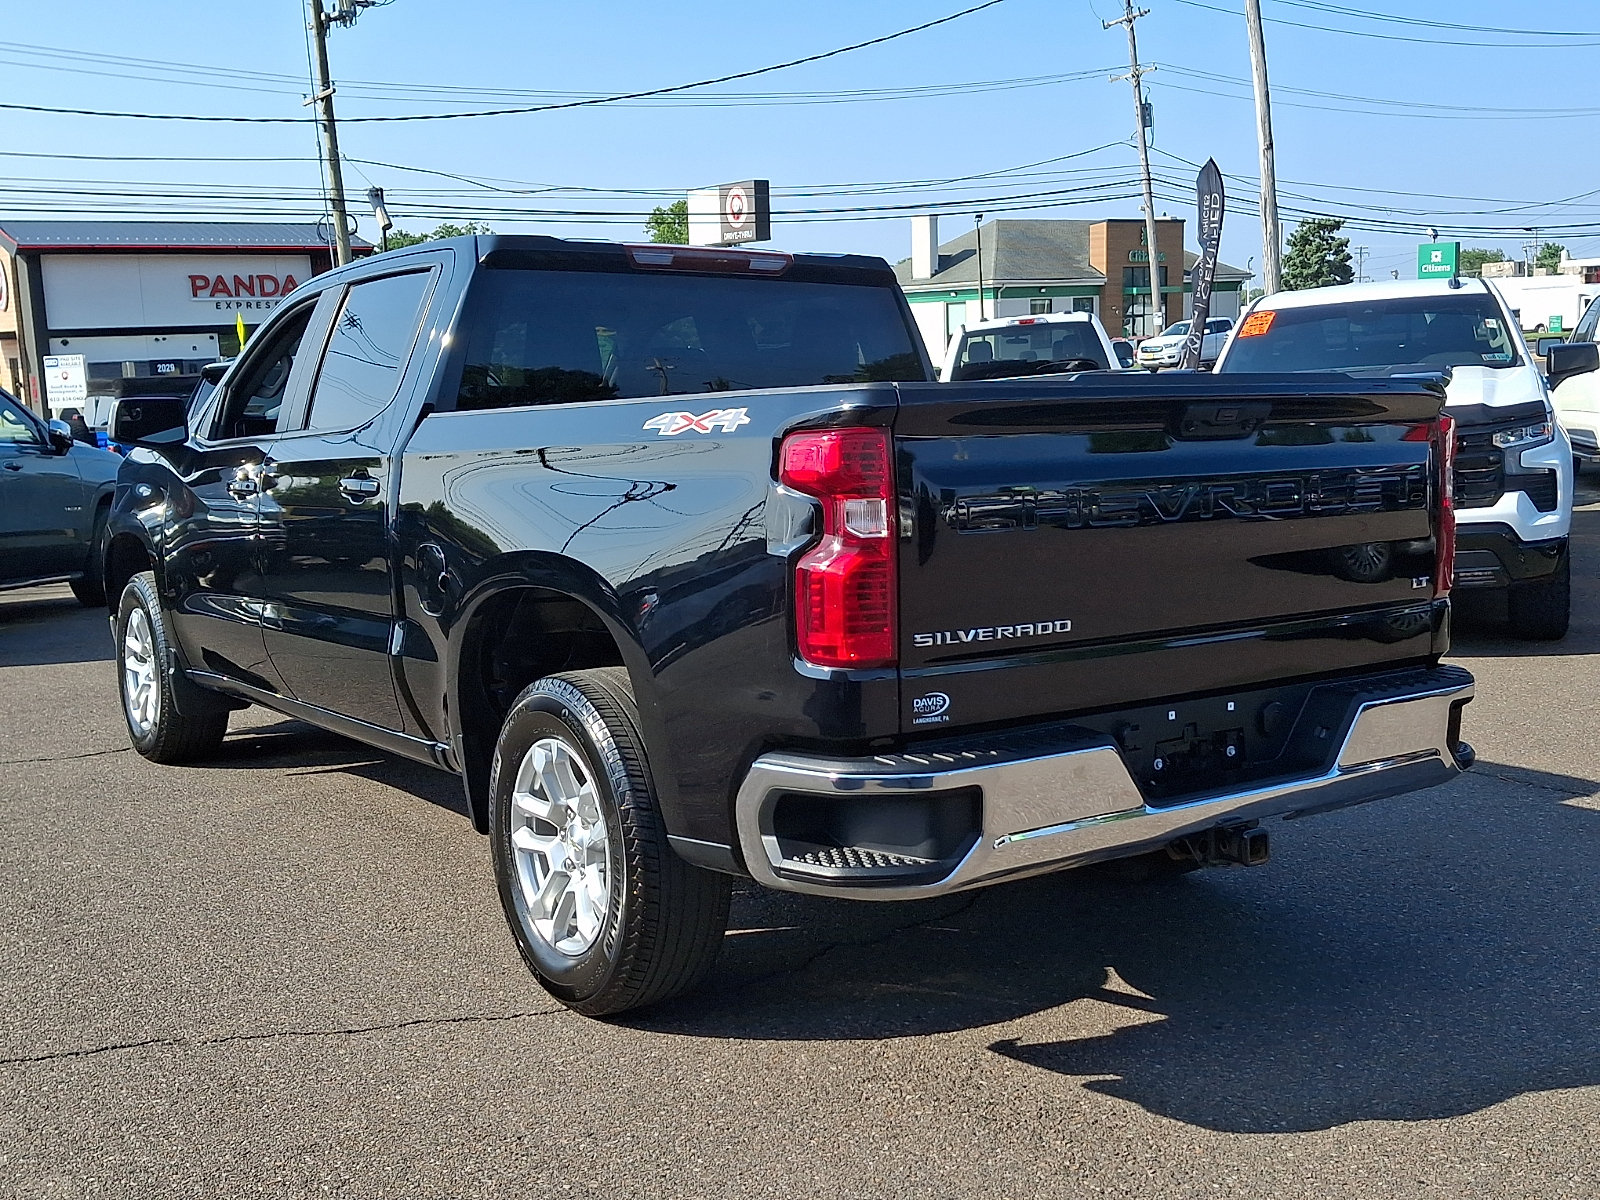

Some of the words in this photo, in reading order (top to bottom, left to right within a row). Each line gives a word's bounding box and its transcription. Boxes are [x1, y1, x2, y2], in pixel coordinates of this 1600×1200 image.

[723, 230, 753, 241] DRIVE-THRU
[1421, 263, 1452, 273] Citizens
[188, 274, 300, 298] PANDA
[156, 363, 175, 373] 2029
[954, 470, 1425, 535] CHEVROLET
[1412, 576, 1430, 589] LT
[913, 619, 1072, 647] SILVERADO
[913, 696, 944, 708] DAVIS
[913, 704, 941, 713] ACURA
[605, 853, 622, 956] MICHELIN
